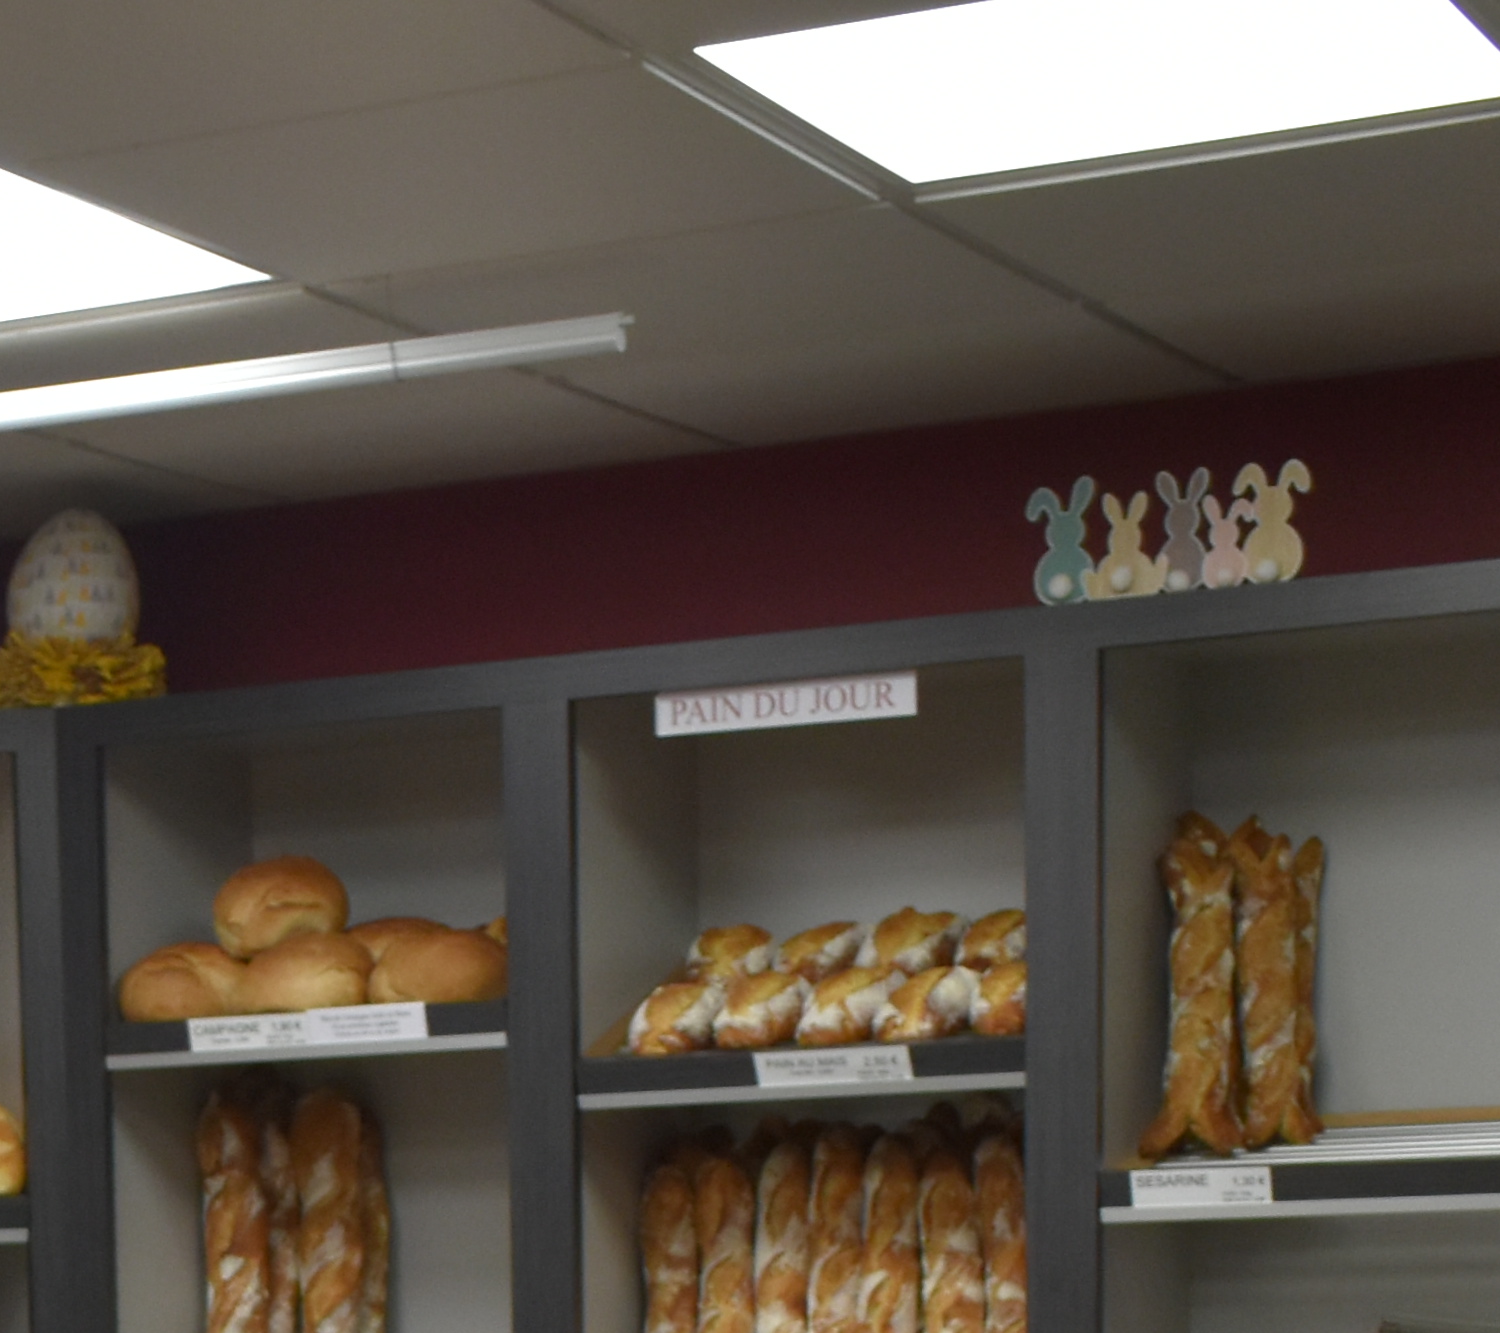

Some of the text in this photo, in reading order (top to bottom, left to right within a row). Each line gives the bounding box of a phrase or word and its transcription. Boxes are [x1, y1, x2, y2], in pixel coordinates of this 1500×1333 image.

[670, 682, 895, 728] PAIN DU JOUR
[1136, 1174, 1209, 1187] SESARINE
